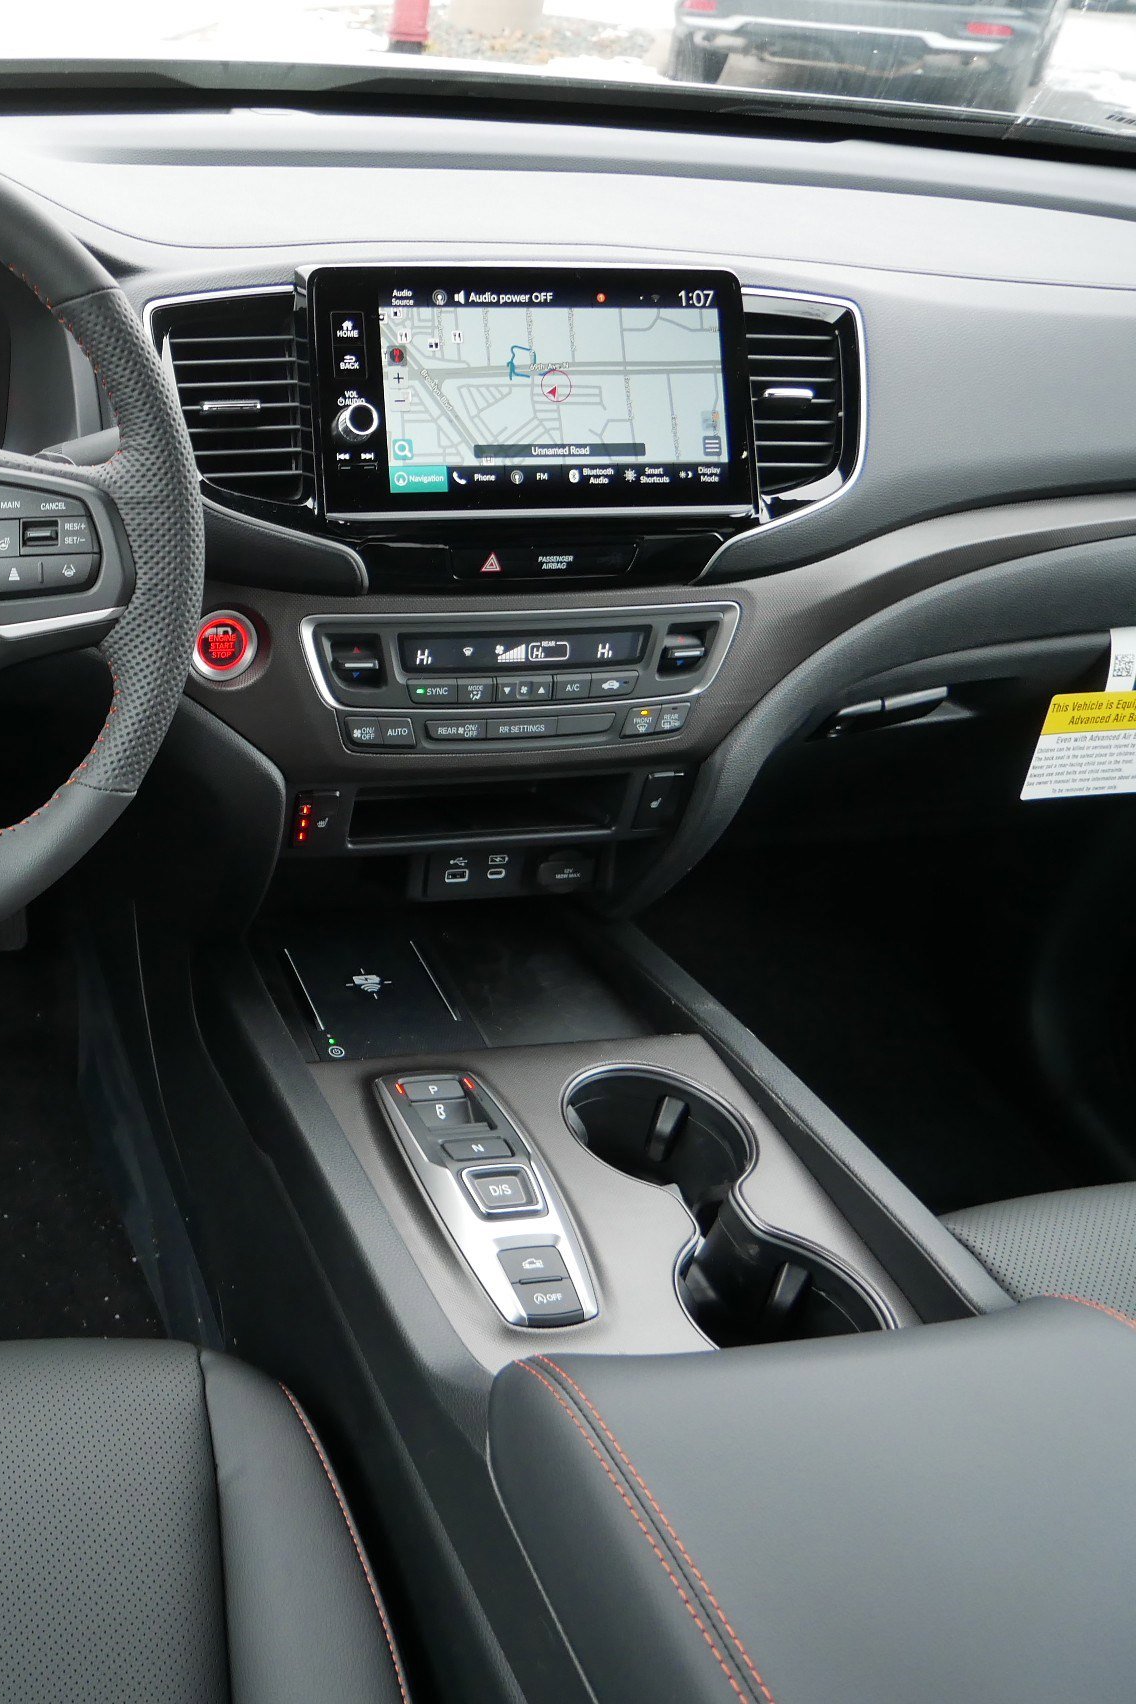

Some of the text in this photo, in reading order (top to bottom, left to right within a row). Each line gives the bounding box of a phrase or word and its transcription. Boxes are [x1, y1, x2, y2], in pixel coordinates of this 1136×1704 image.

[469, 292, 553, 305] Audio power OFF
[678, 290, 714, 306] 1:07
[340, 361, 359, 370] BACK
[420, 369, 441, 395] Brooklyn
[532, 446, 590, 455] Unnamed Road
[41, 502, 66, 510] CANCEL
[566, 684, 579, 692] A/C
[1052, 703, 1069, 713] This
[1072, 701, 1103, 712] Vehicle
[1106, 700, 1113, 709] is
[1068, 714, 1126, 725] Advanced Air
[510, 724, 544, 733] SETTINGS
[429, 1085, 438, 1094] P
[472, 1144, 485, 1152] N
[489, 1185, 512, 1196] D/S
[547, 1293, 562, 1301] OFF
